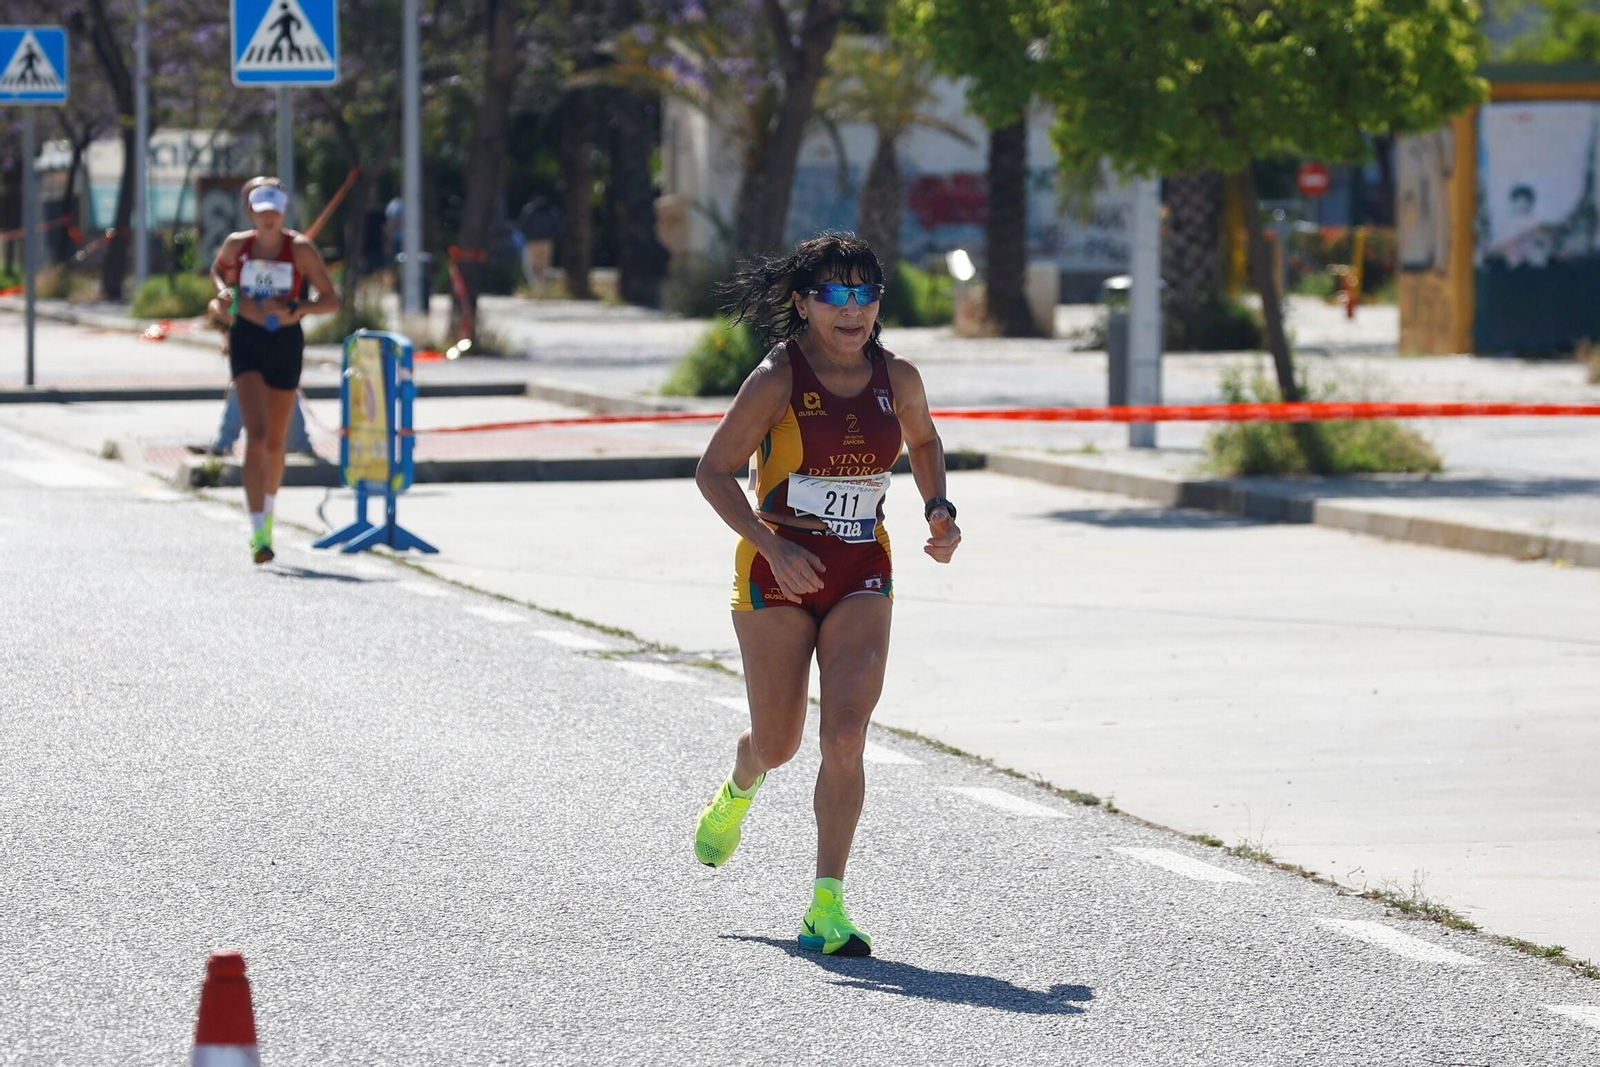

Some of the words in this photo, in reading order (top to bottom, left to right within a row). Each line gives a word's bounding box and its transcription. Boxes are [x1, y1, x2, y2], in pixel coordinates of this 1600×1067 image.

[255, 272, 273, 287] 66
[828, 453, 876, 466] VINO
[807, 467, 832, 476] DE
[824, 490, 860, 518] 211
